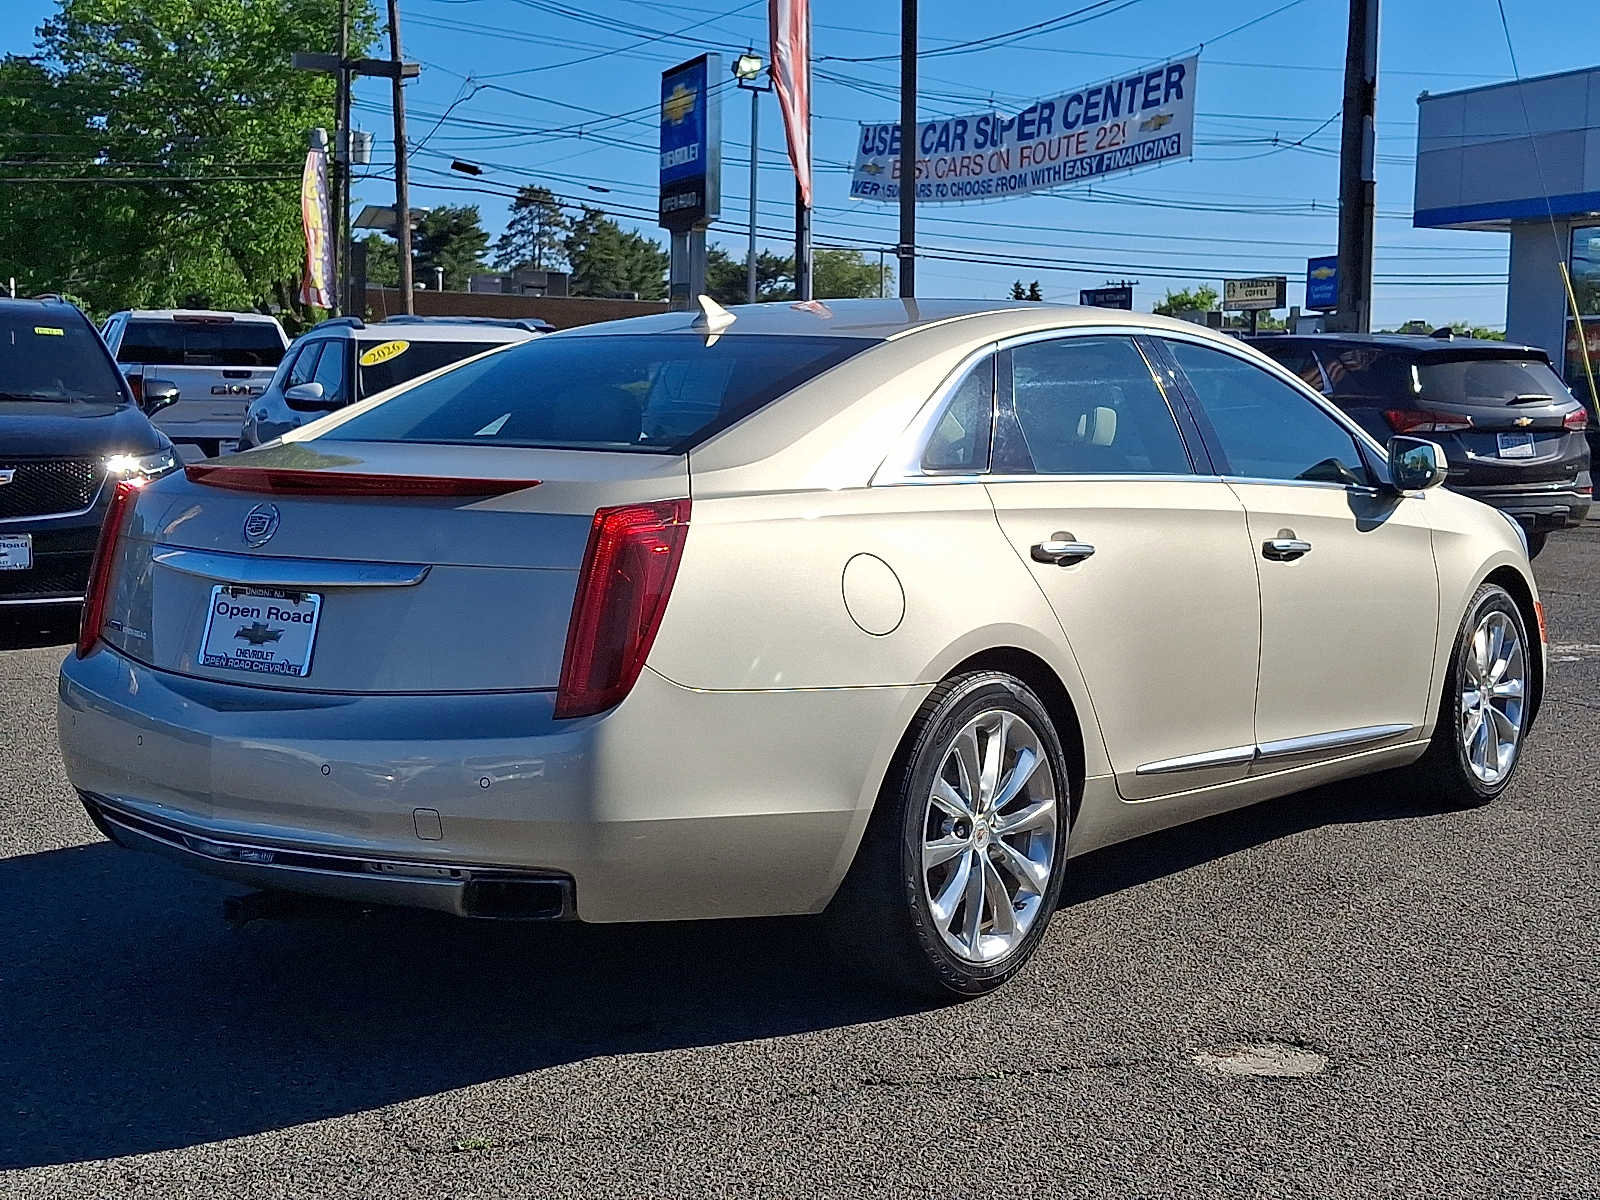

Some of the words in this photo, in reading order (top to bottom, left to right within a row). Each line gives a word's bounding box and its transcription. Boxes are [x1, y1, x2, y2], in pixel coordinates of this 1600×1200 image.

[862, 125, 902, 156] USE
[920, 119, 968, 155] CAR
[974, 101, 1056, 149] SUPER
[1063, 64, 1186, 130] CENTER
[891, 159, 931, 180] BST
[935, 154, 984, 179] CARS
[988, 148, 1010, 174] ON
[1020, 130, 1089, 169] ROUTE
[1095, 121, 1127, 151] 22!
[851, 180, 880, 196] VER
[935, 183, 949, 198] TO
[950, 179, 993, 197] CHOOSE
[995, 172, 1027, 192] FROM
[1031, 164, 1062, 186] WITH
[1064, 155, 1100, 180] EASY
[1102, 136, 1179, 172] FINANCING
[368, 343, 401, 363] 2026
[274, 590, 286, 599] NJ
[216, 601, 261, 619] Open
[266, 606, 315, 624] Road
[235, 648, 276, 661] CHEVROLET
[204, 656, 227, 666] OPEN
[228, 660, 251, 670] ROAD
[253, 662, 301, 675] CHEVROLET
